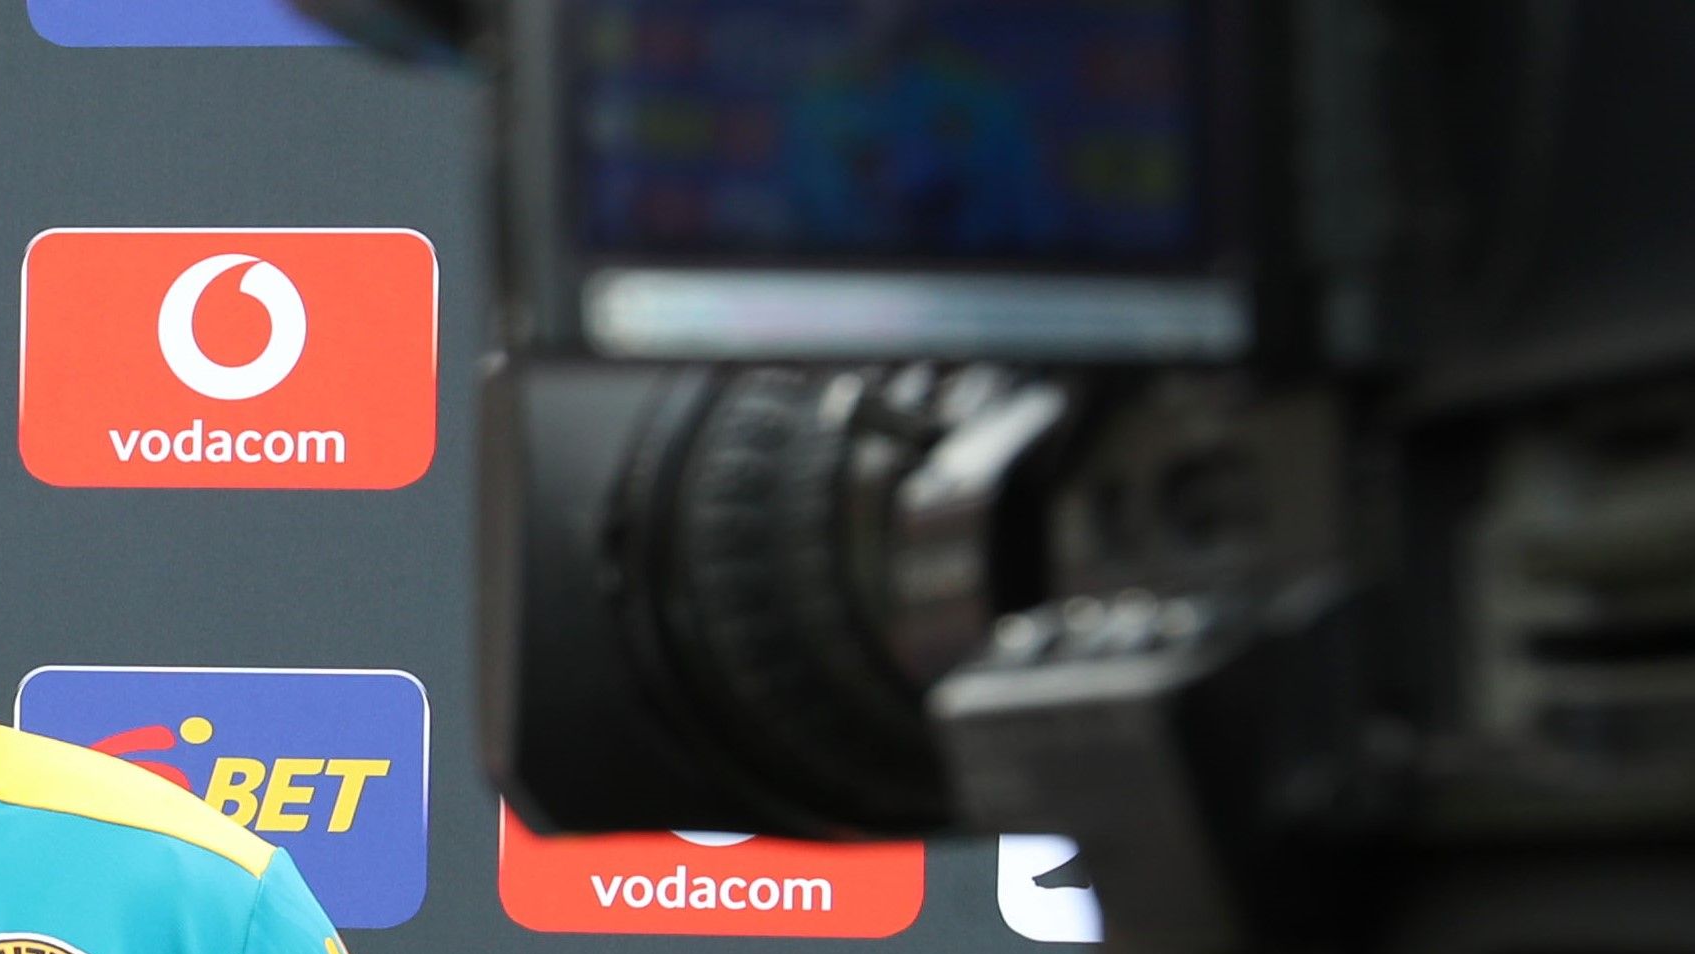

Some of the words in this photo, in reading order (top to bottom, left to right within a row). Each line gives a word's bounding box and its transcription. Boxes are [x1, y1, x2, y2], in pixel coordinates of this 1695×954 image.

[108, 418, 346, 463] vodacom
[204, 757, 391, 832] BET
[590, 865, 832, 911] vodacom
